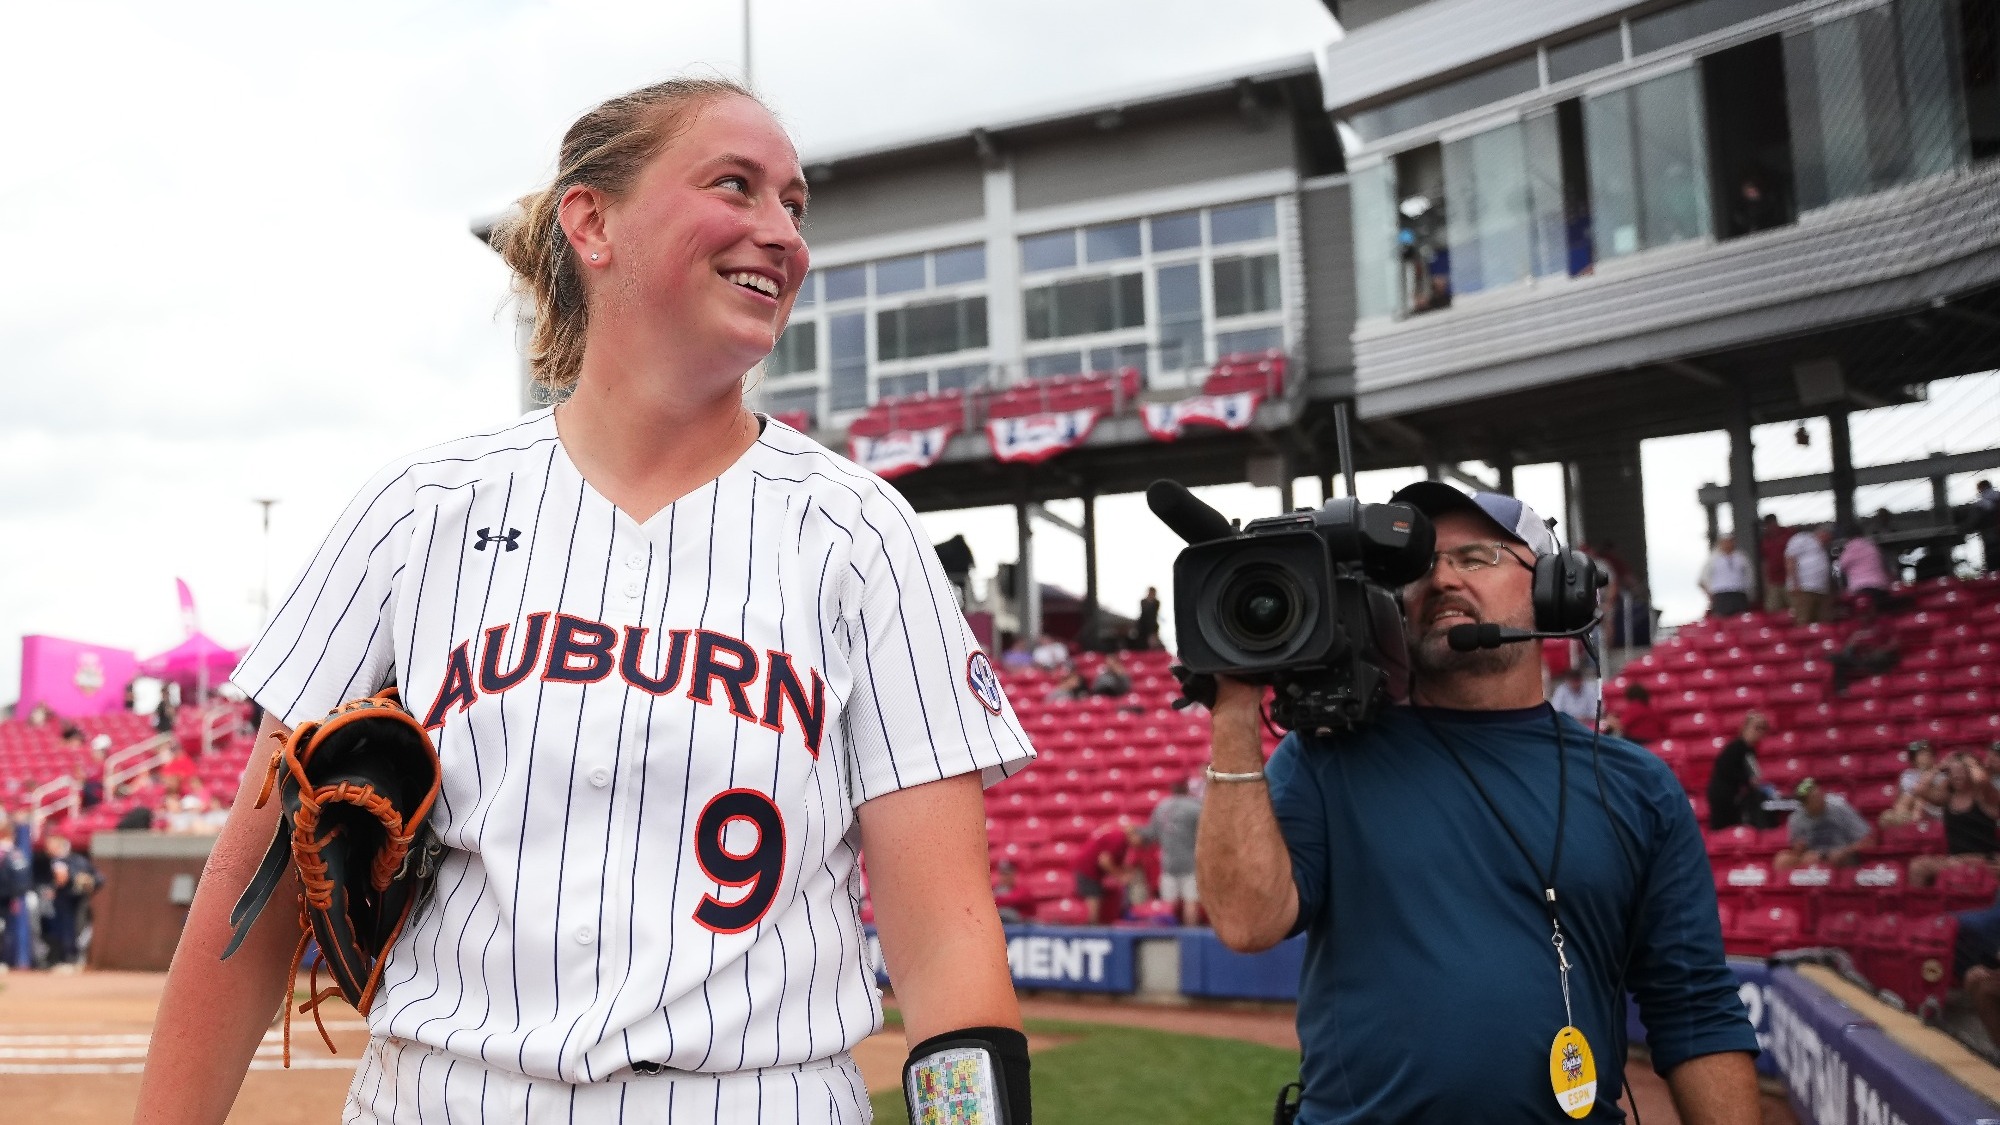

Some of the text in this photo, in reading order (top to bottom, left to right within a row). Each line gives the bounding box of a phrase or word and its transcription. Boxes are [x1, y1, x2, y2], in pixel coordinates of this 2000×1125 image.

[423, 611, 826, 760] AUBURN
[692, 787, 787, 934] 9
[1567, 1088, 1591, 1106] ESPN
